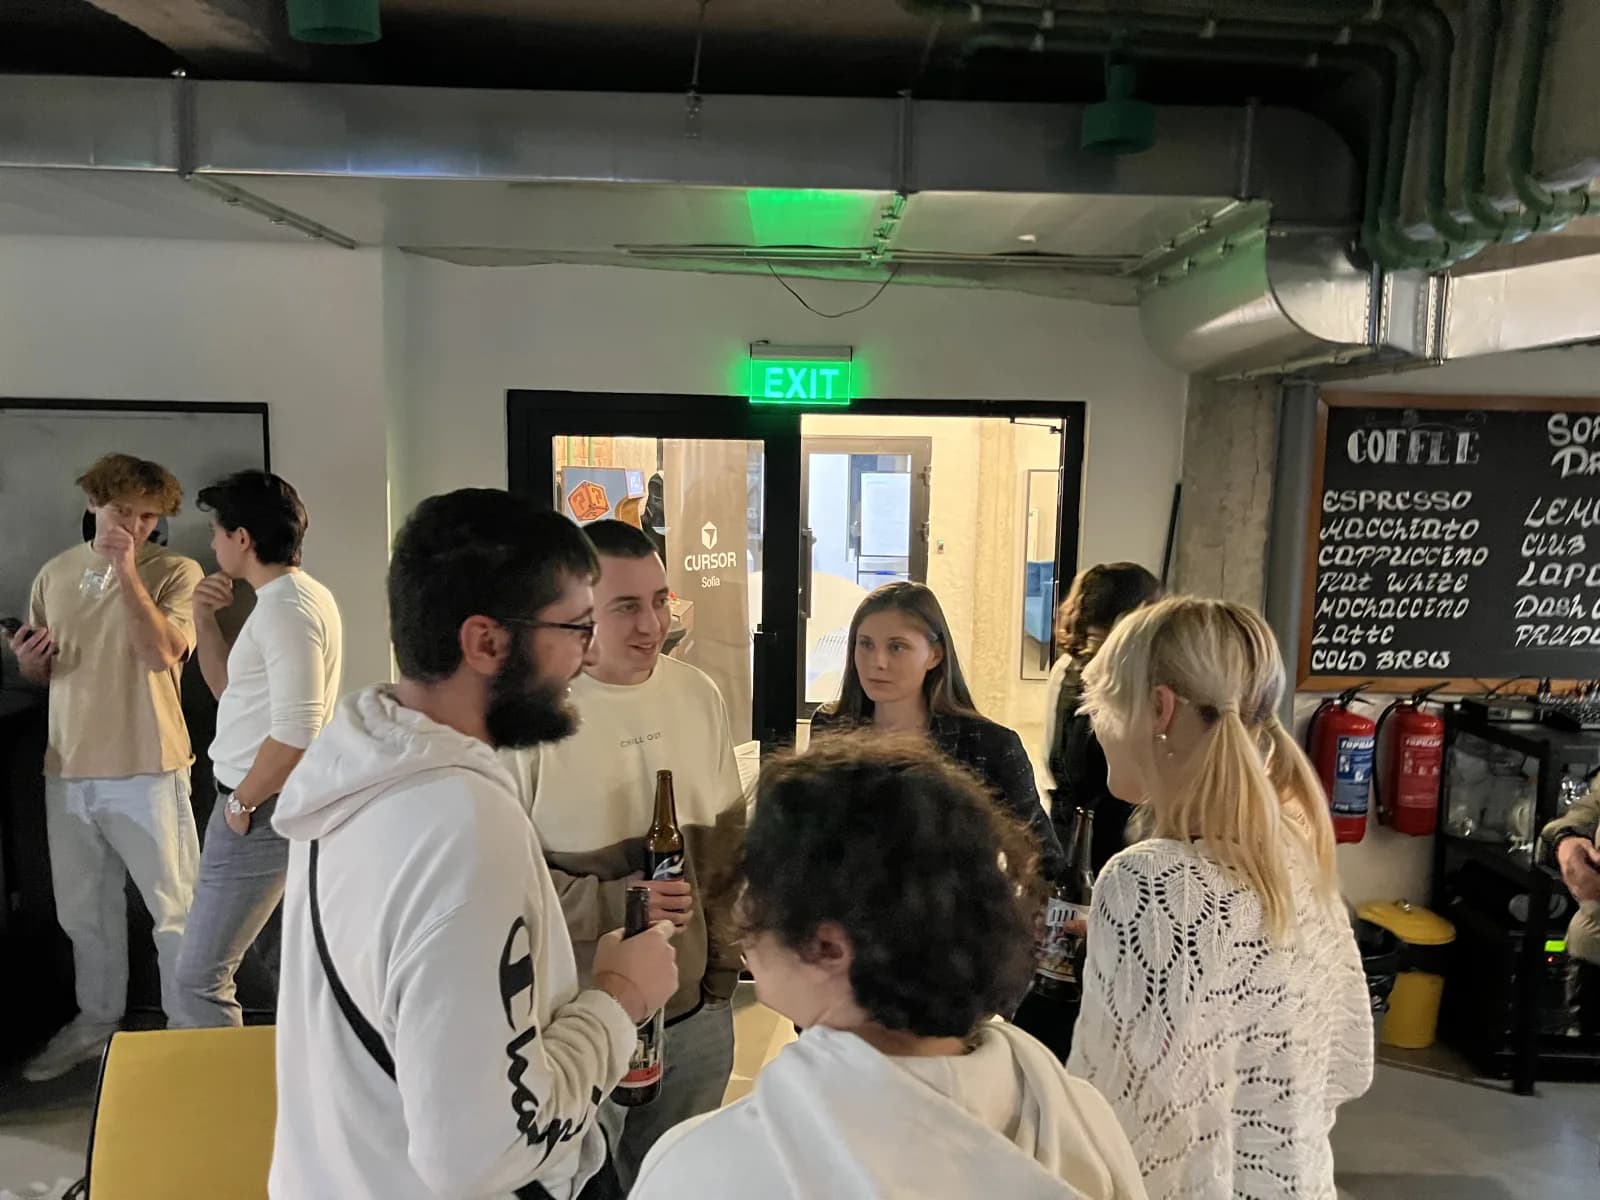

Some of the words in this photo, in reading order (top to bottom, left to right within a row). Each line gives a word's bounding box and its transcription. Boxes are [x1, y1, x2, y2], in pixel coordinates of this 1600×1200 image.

[764, 367, 839, 399] EXIT
[1347, 429, 1480, 465] COFFEE
[1322, 490, 1472, 513] ESPRESSO
[684, 551, 737, 571] CURSOR
[701, 575, 720, 588] Sofia
[1376, 651, 1450, 672] BREW
